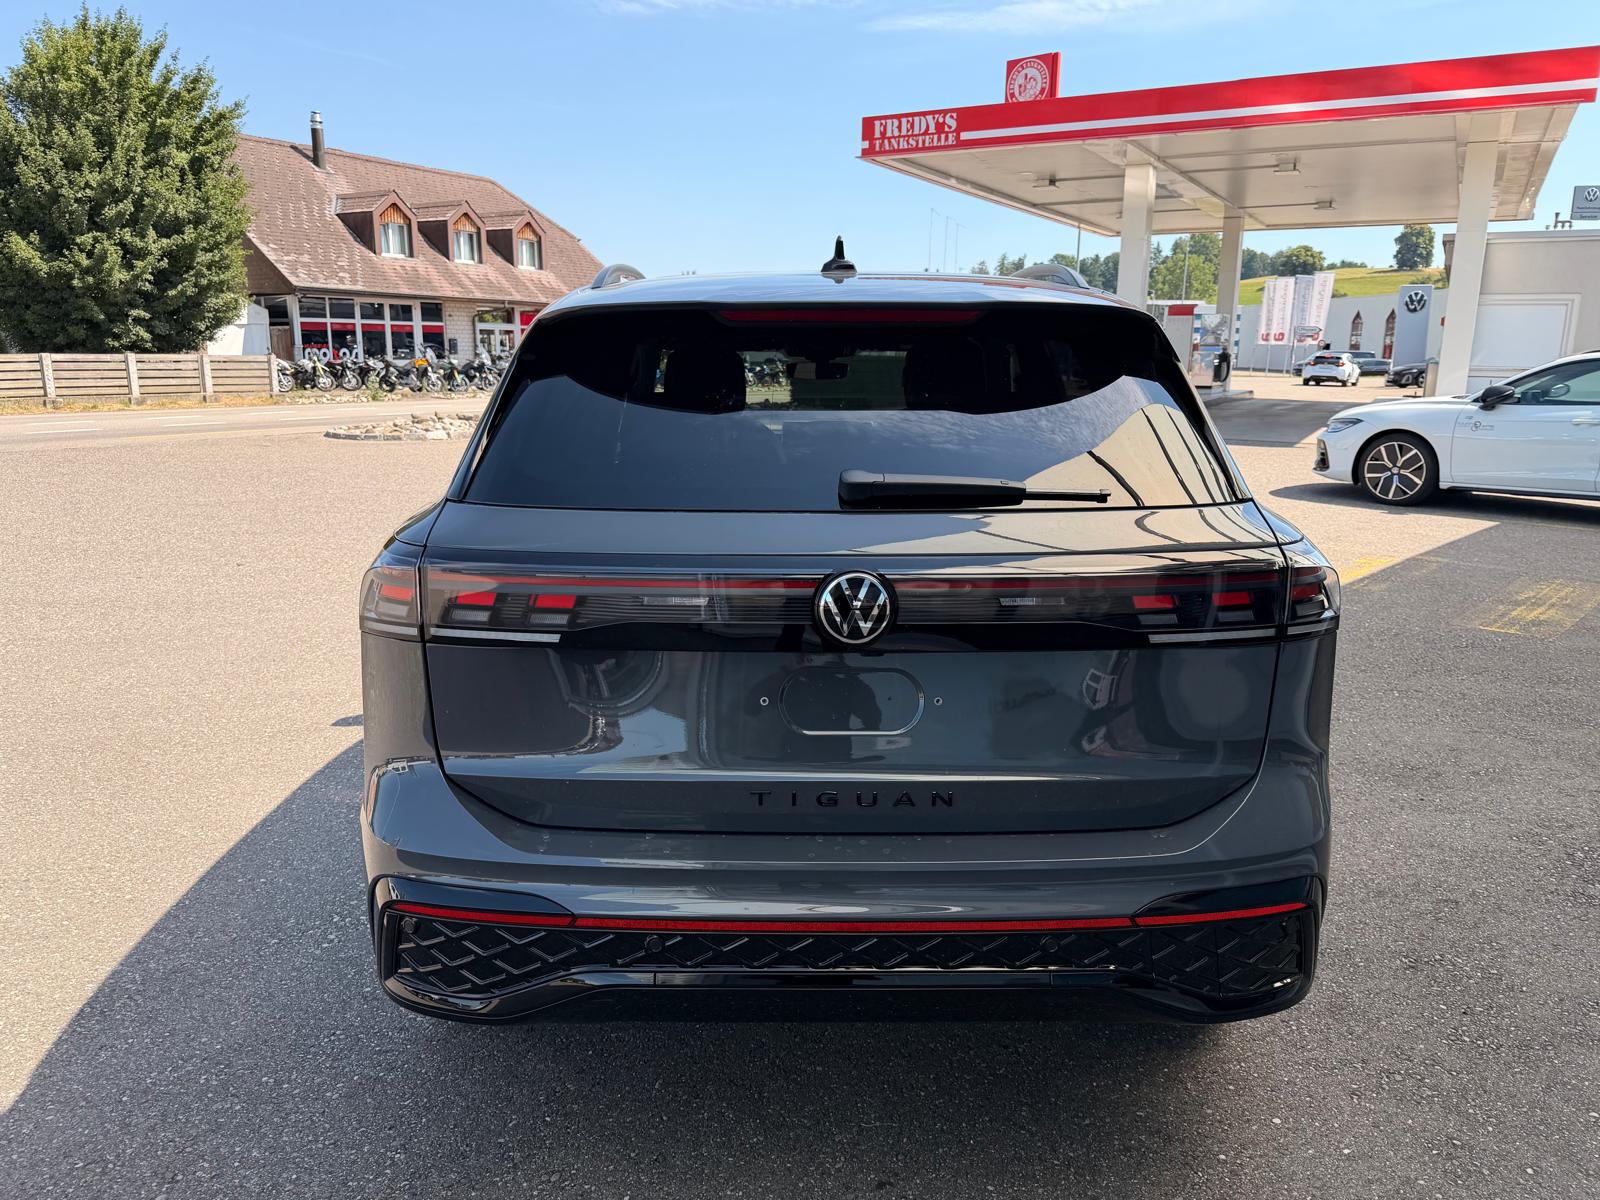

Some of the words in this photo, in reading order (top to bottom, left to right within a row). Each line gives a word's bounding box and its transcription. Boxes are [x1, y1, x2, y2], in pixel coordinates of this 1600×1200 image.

[874, 112, 957, 138] FREDY'S
[874, 133, 957, 152] TANKSTELLE
[750, 790, 954, 808] TIGUAN
